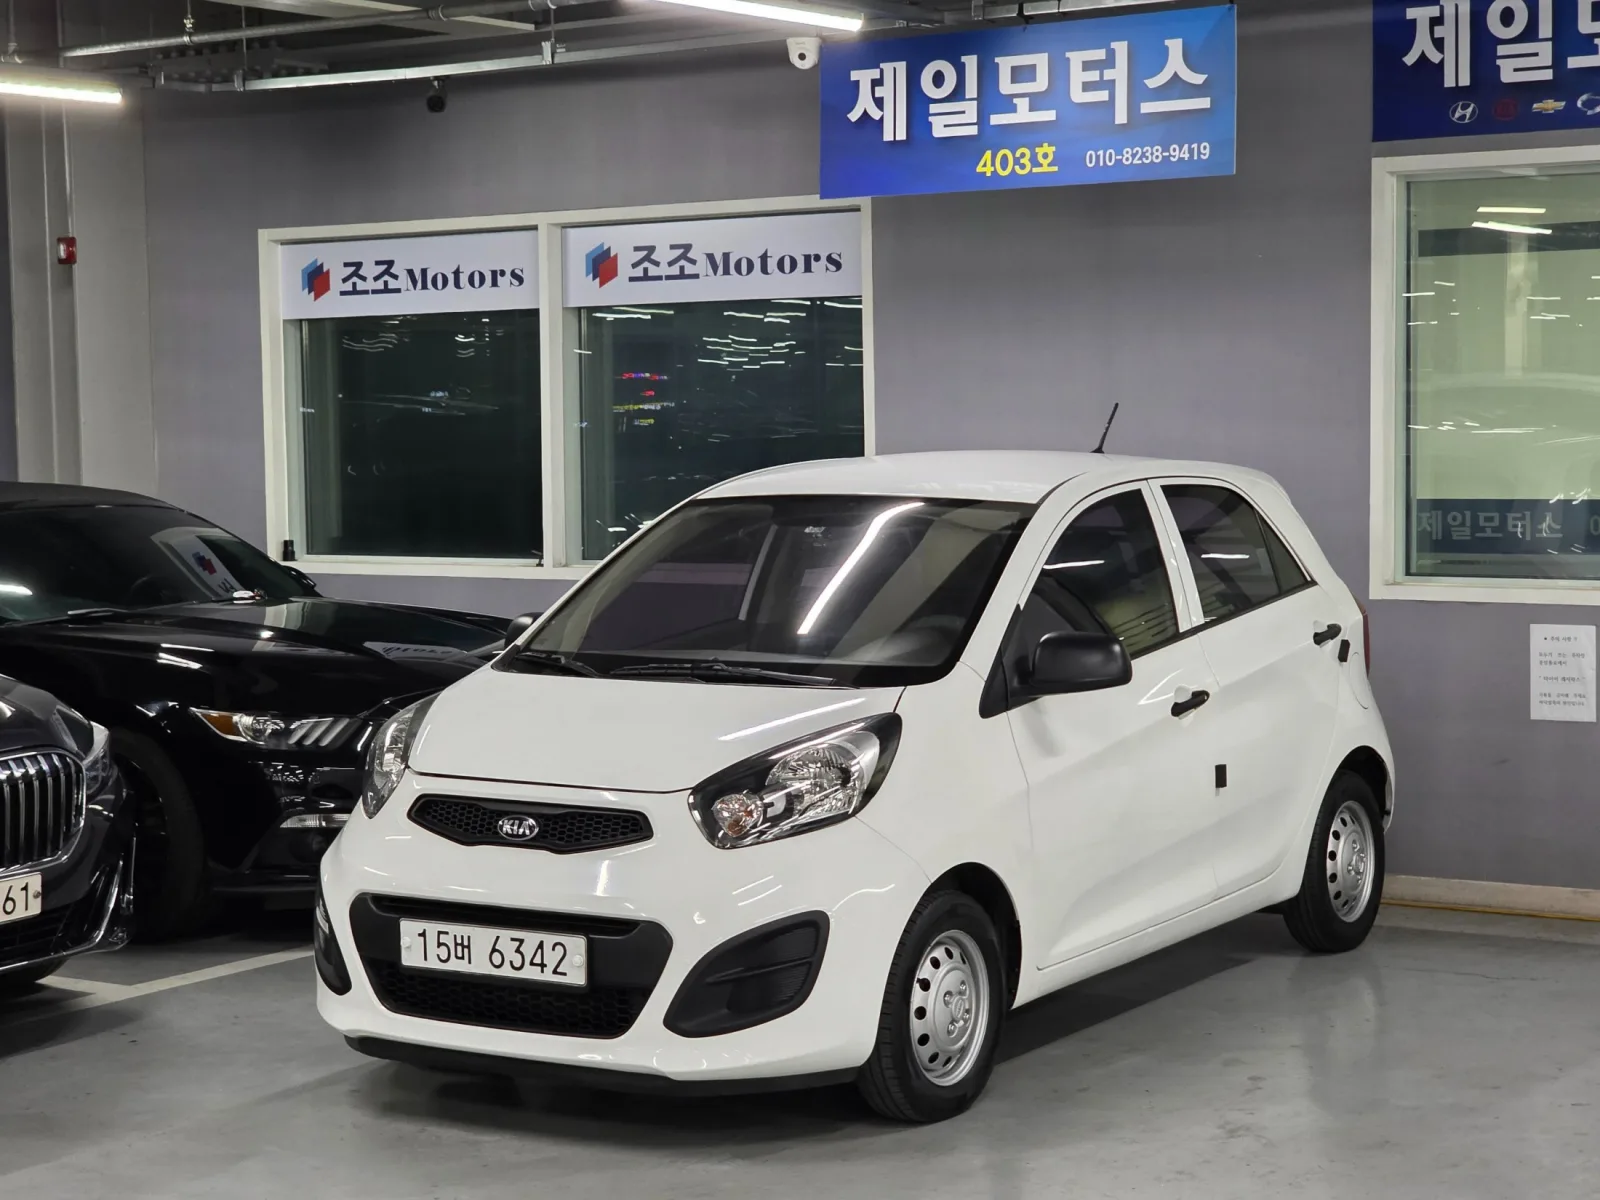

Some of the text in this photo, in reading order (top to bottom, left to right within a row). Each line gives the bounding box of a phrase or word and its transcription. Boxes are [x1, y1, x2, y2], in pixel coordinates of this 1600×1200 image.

[846, 38, 1211, 142] 제일모터스
[975, 142, 1210, 177] 403호 010-8238-9419
[1418, 510, 1563, 541] 제일모터스
[502, 819, 531, 836] KIA
[2, 881, 29, 916] 61
[417, 928, 568, 977] 15버 6342
